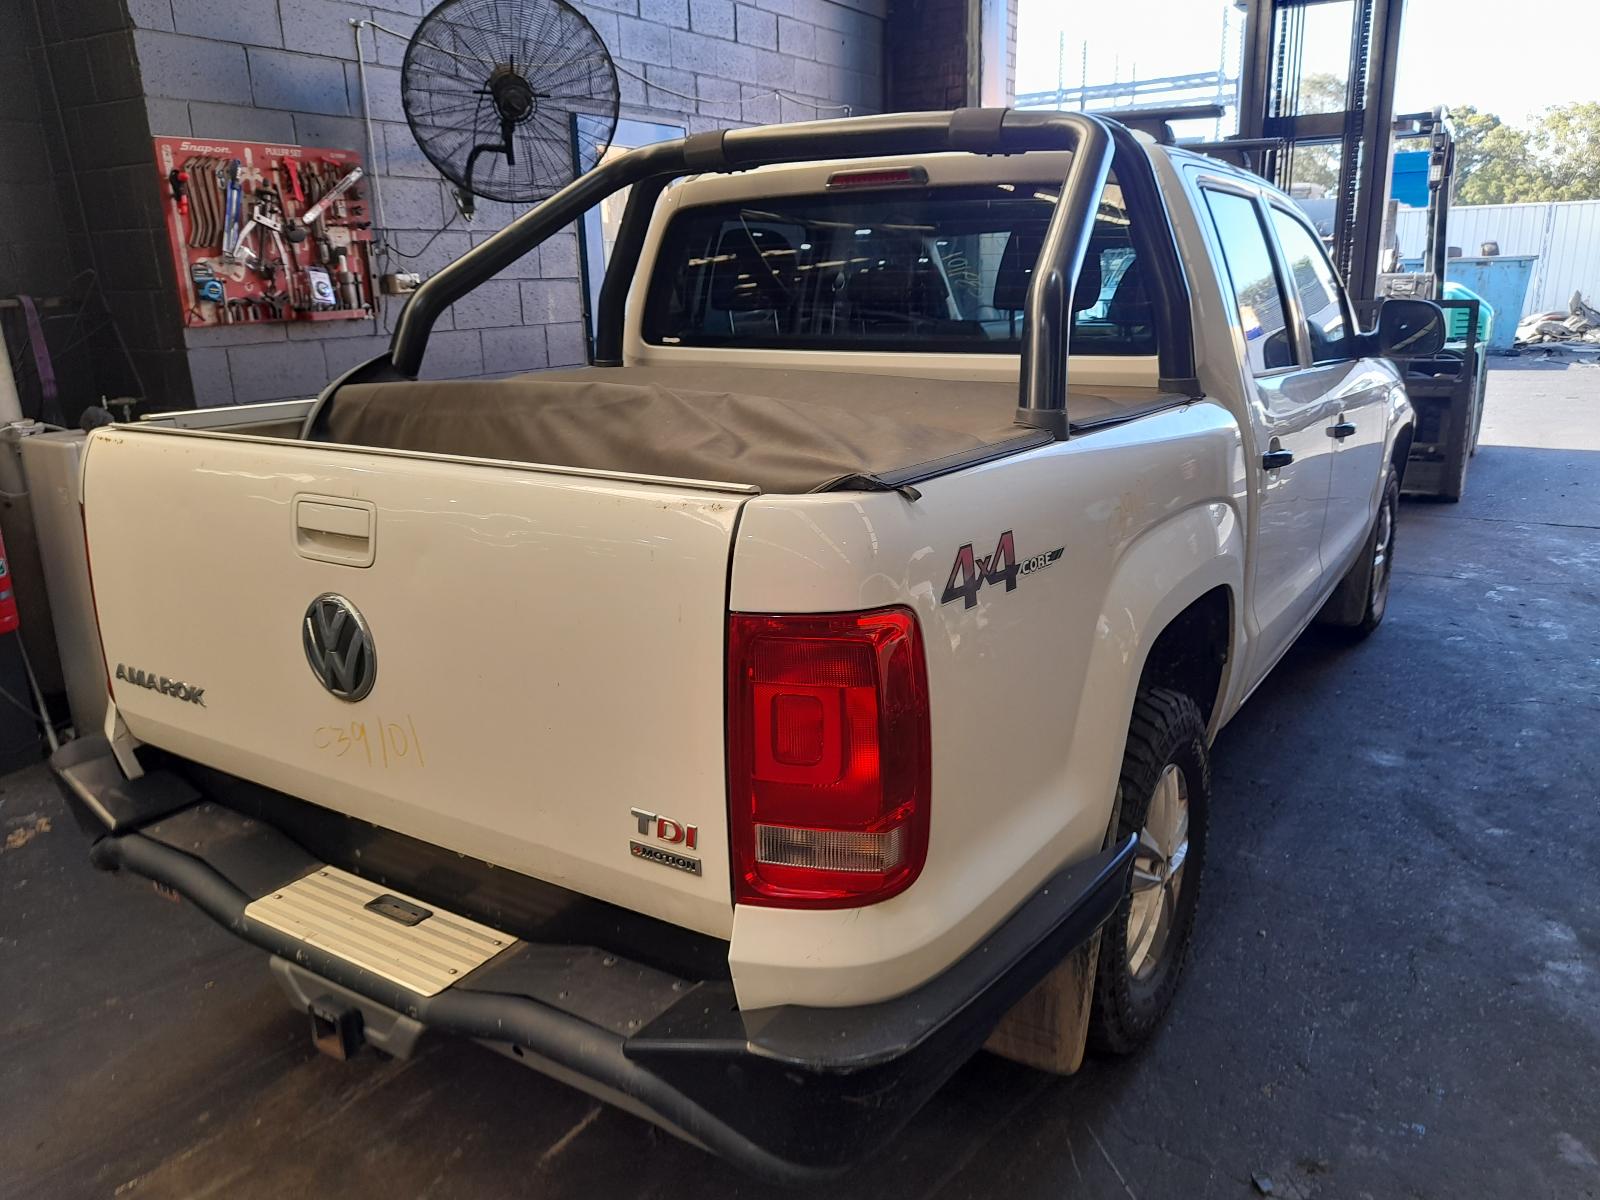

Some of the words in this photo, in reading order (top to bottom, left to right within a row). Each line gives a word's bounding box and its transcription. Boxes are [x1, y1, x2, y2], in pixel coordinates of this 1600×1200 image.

[940, 529, 1017, 610] 4x4
[1020, 551, 1054, 576] CORE
[115, 663, 207, 708] AMAROK
[630, 806, 698, 850] TDI
[632, 845, 697, 873] 4MOTION
